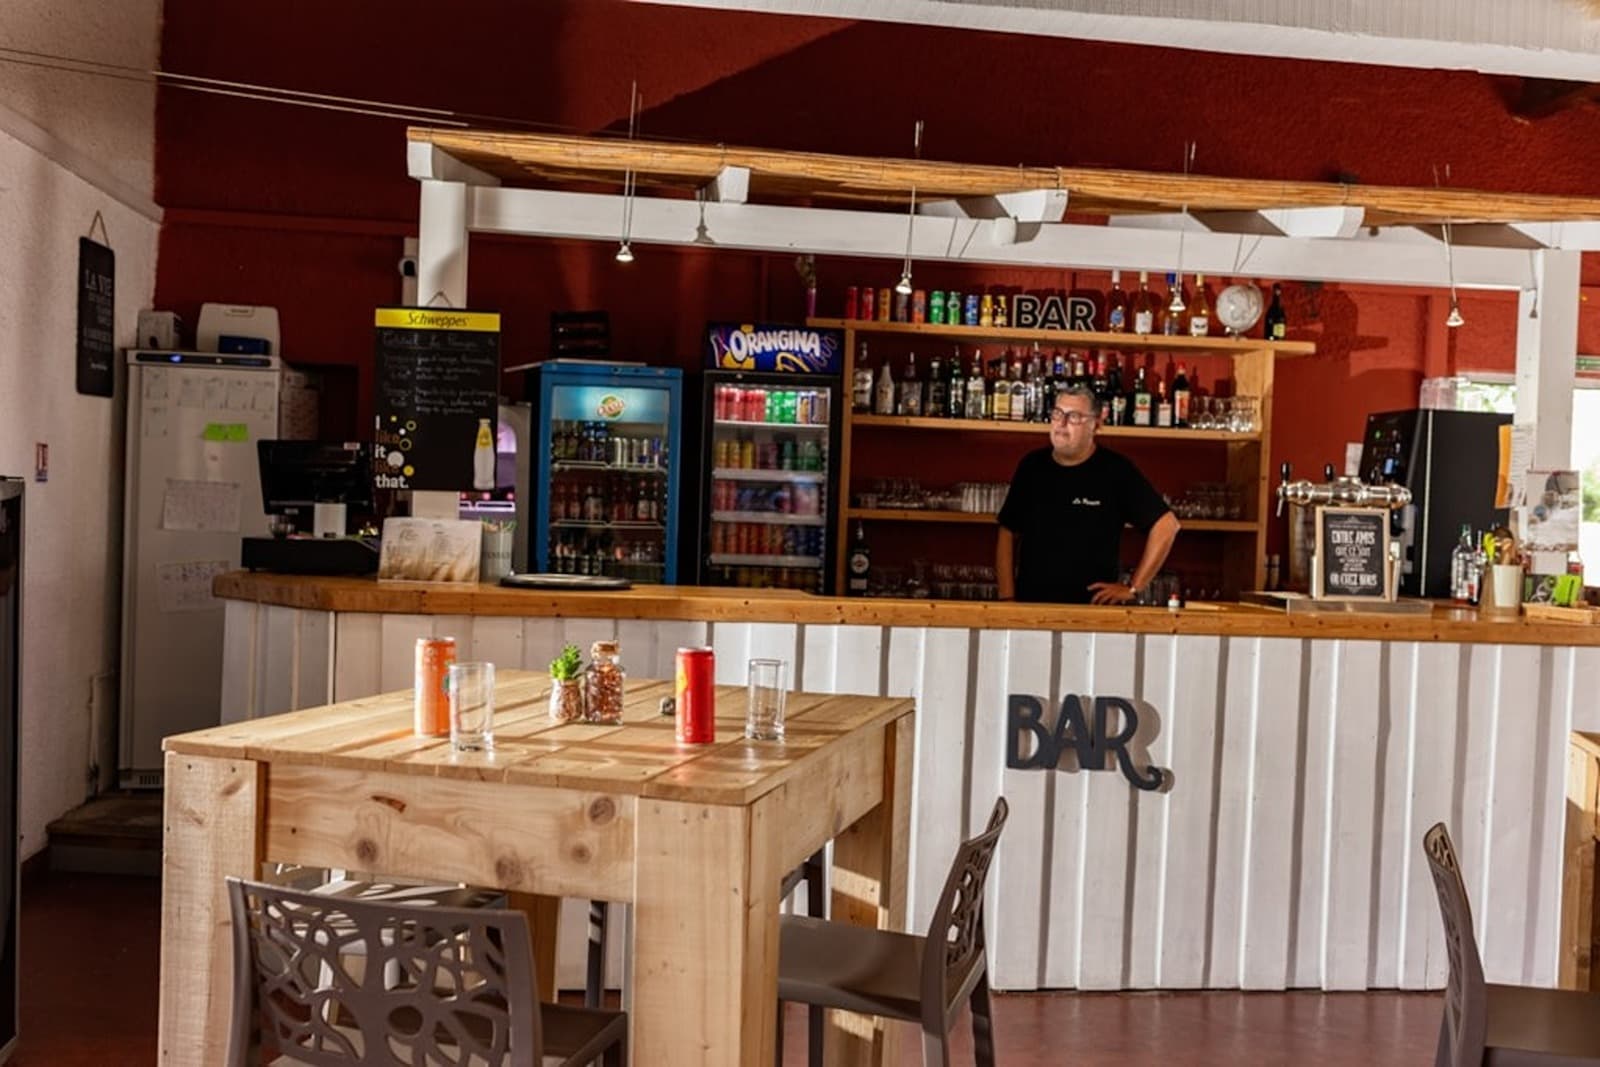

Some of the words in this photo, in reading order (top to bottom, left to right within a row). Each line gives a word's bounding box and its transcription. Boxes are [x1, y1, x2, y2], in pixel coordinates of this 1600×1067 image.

[85, 268, 97, 290] LA
[98, 274, 112, 297] VIE
[408, 311, 468, 328] Schweppes
[1013, 295, 1097, 331] BAR
[374, 444, 387, 458] it
[374, 473, 409, 488] that.
[1331, 530, 1354, 544] ENTRE
[1355, 530, 1375, 545] AMIS
[1006, 694, 1163, 791] BAR
